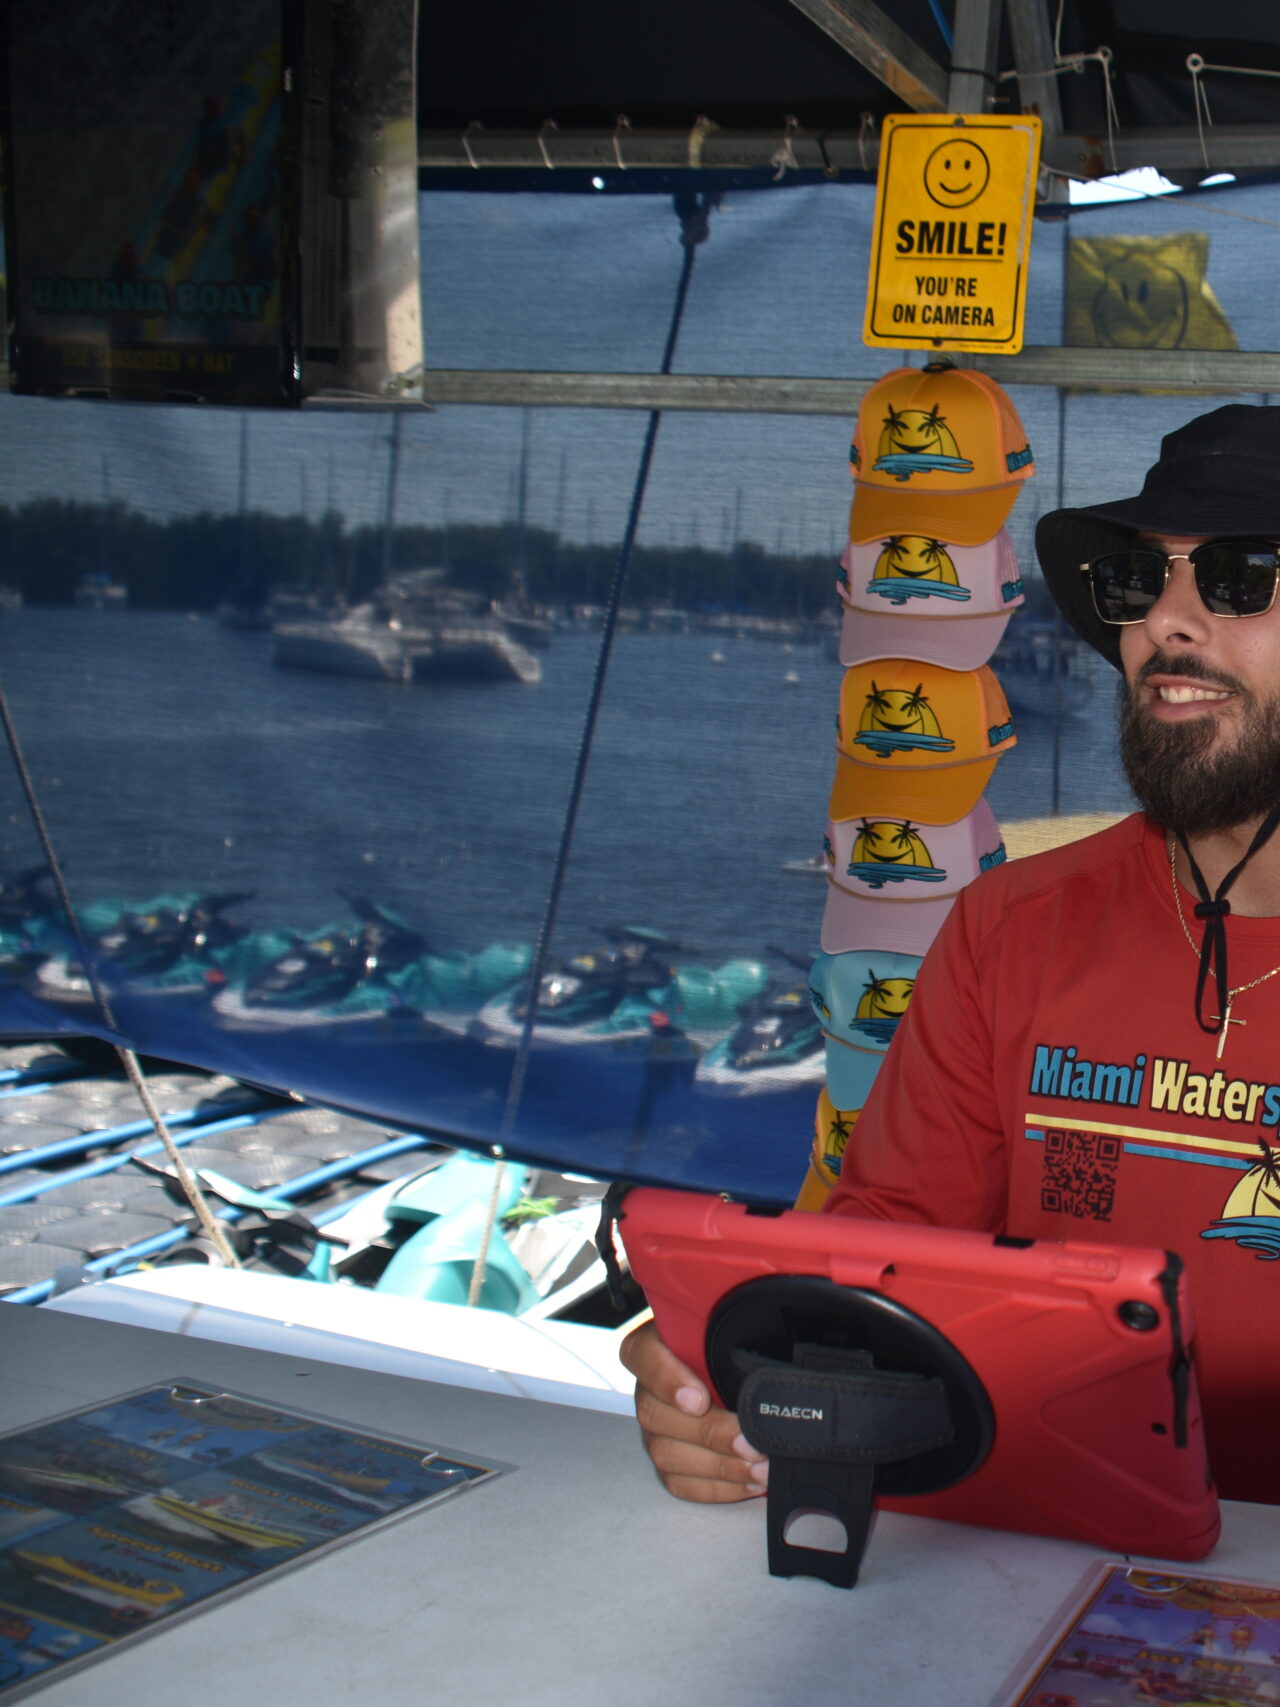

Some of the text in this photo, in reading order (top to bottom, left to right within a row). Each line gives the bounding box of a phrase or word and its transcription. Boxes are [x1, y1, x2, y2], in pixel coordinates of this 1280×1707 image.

[895, 219, 1007, 256] SMILE!
[34, 276, 266, 317] BANANA BOAT
[915, 276, 978, 297] YOU'RE
[892, 303, 995, 327] ON CAMERA
[1029, 1044, 1147, 1106] Miami
[759, 1402, 824, 1420] BRAECN
